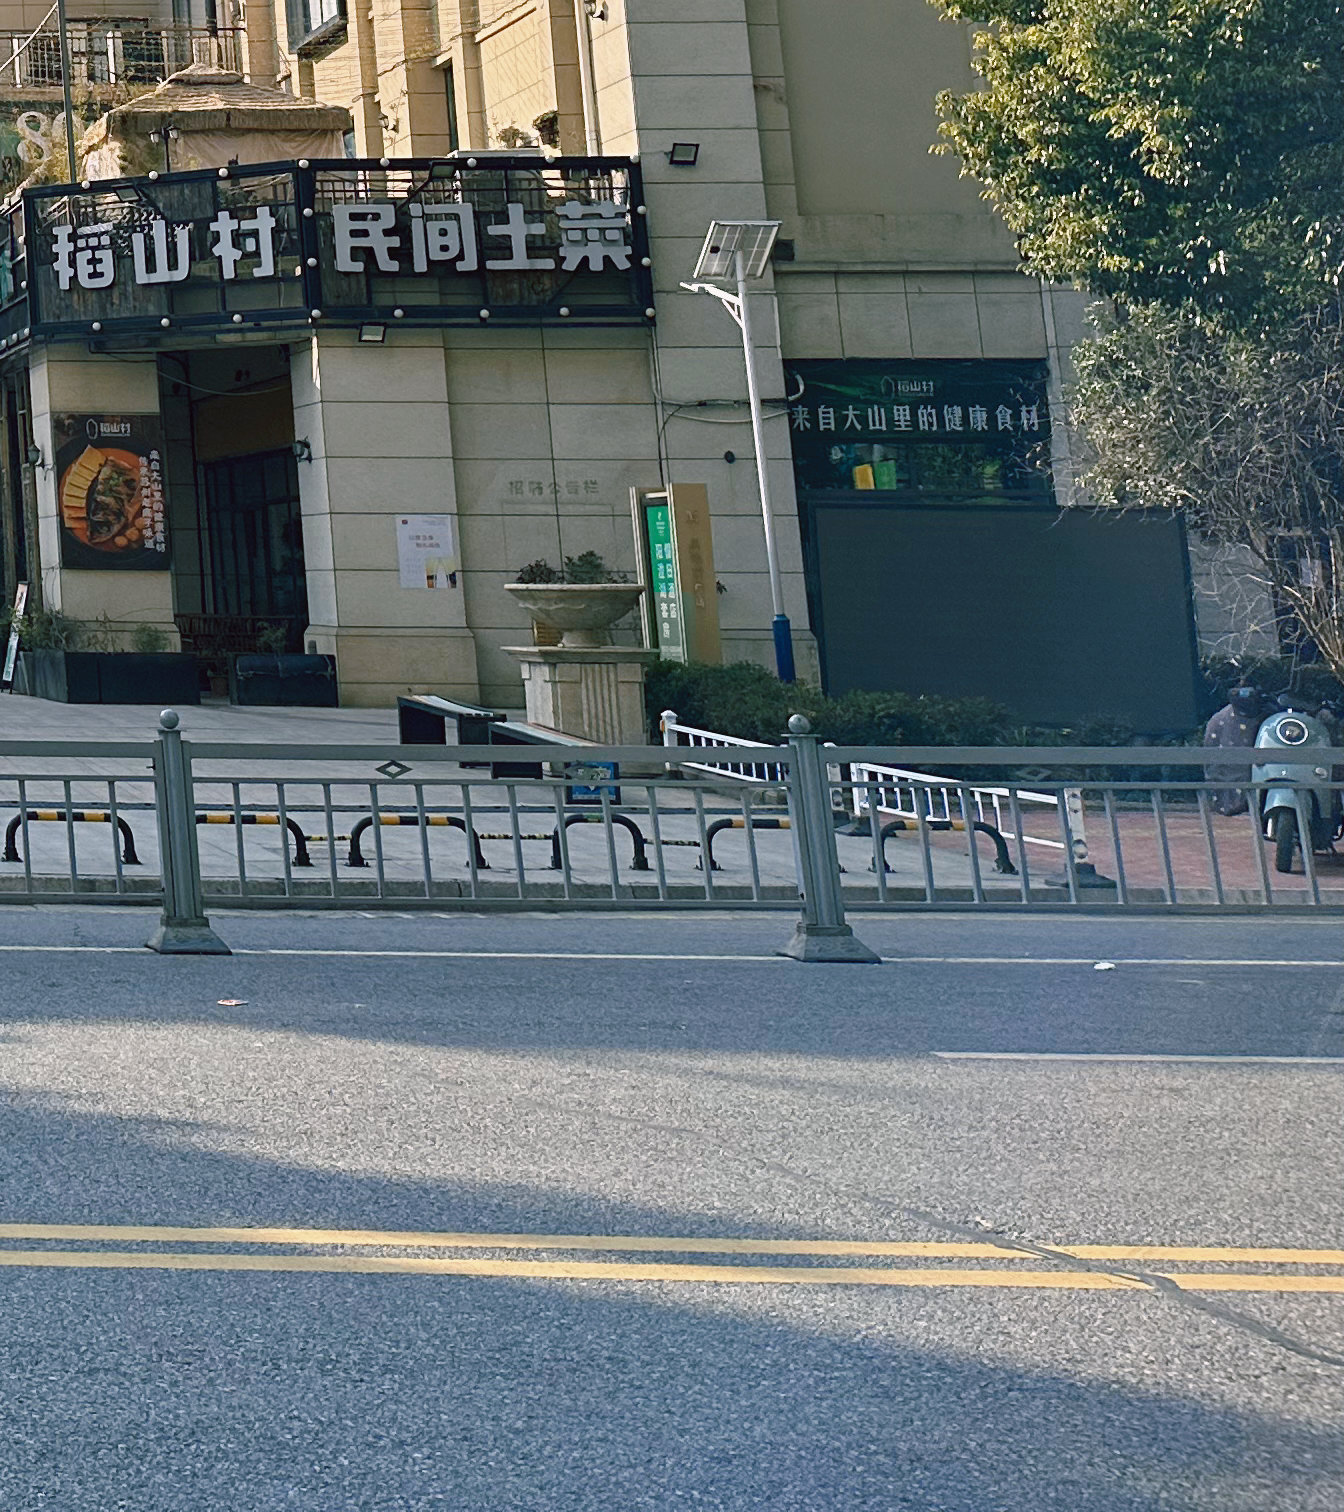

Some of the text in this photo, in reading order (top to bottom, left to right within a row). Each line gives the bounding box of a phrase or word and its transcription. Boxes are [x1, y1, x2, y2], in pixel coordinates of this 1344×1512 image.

[52, 200, 634, 290] 稻山村 民间土菜
[792, 404, 1040, 432] 来自大山里的健康食材
